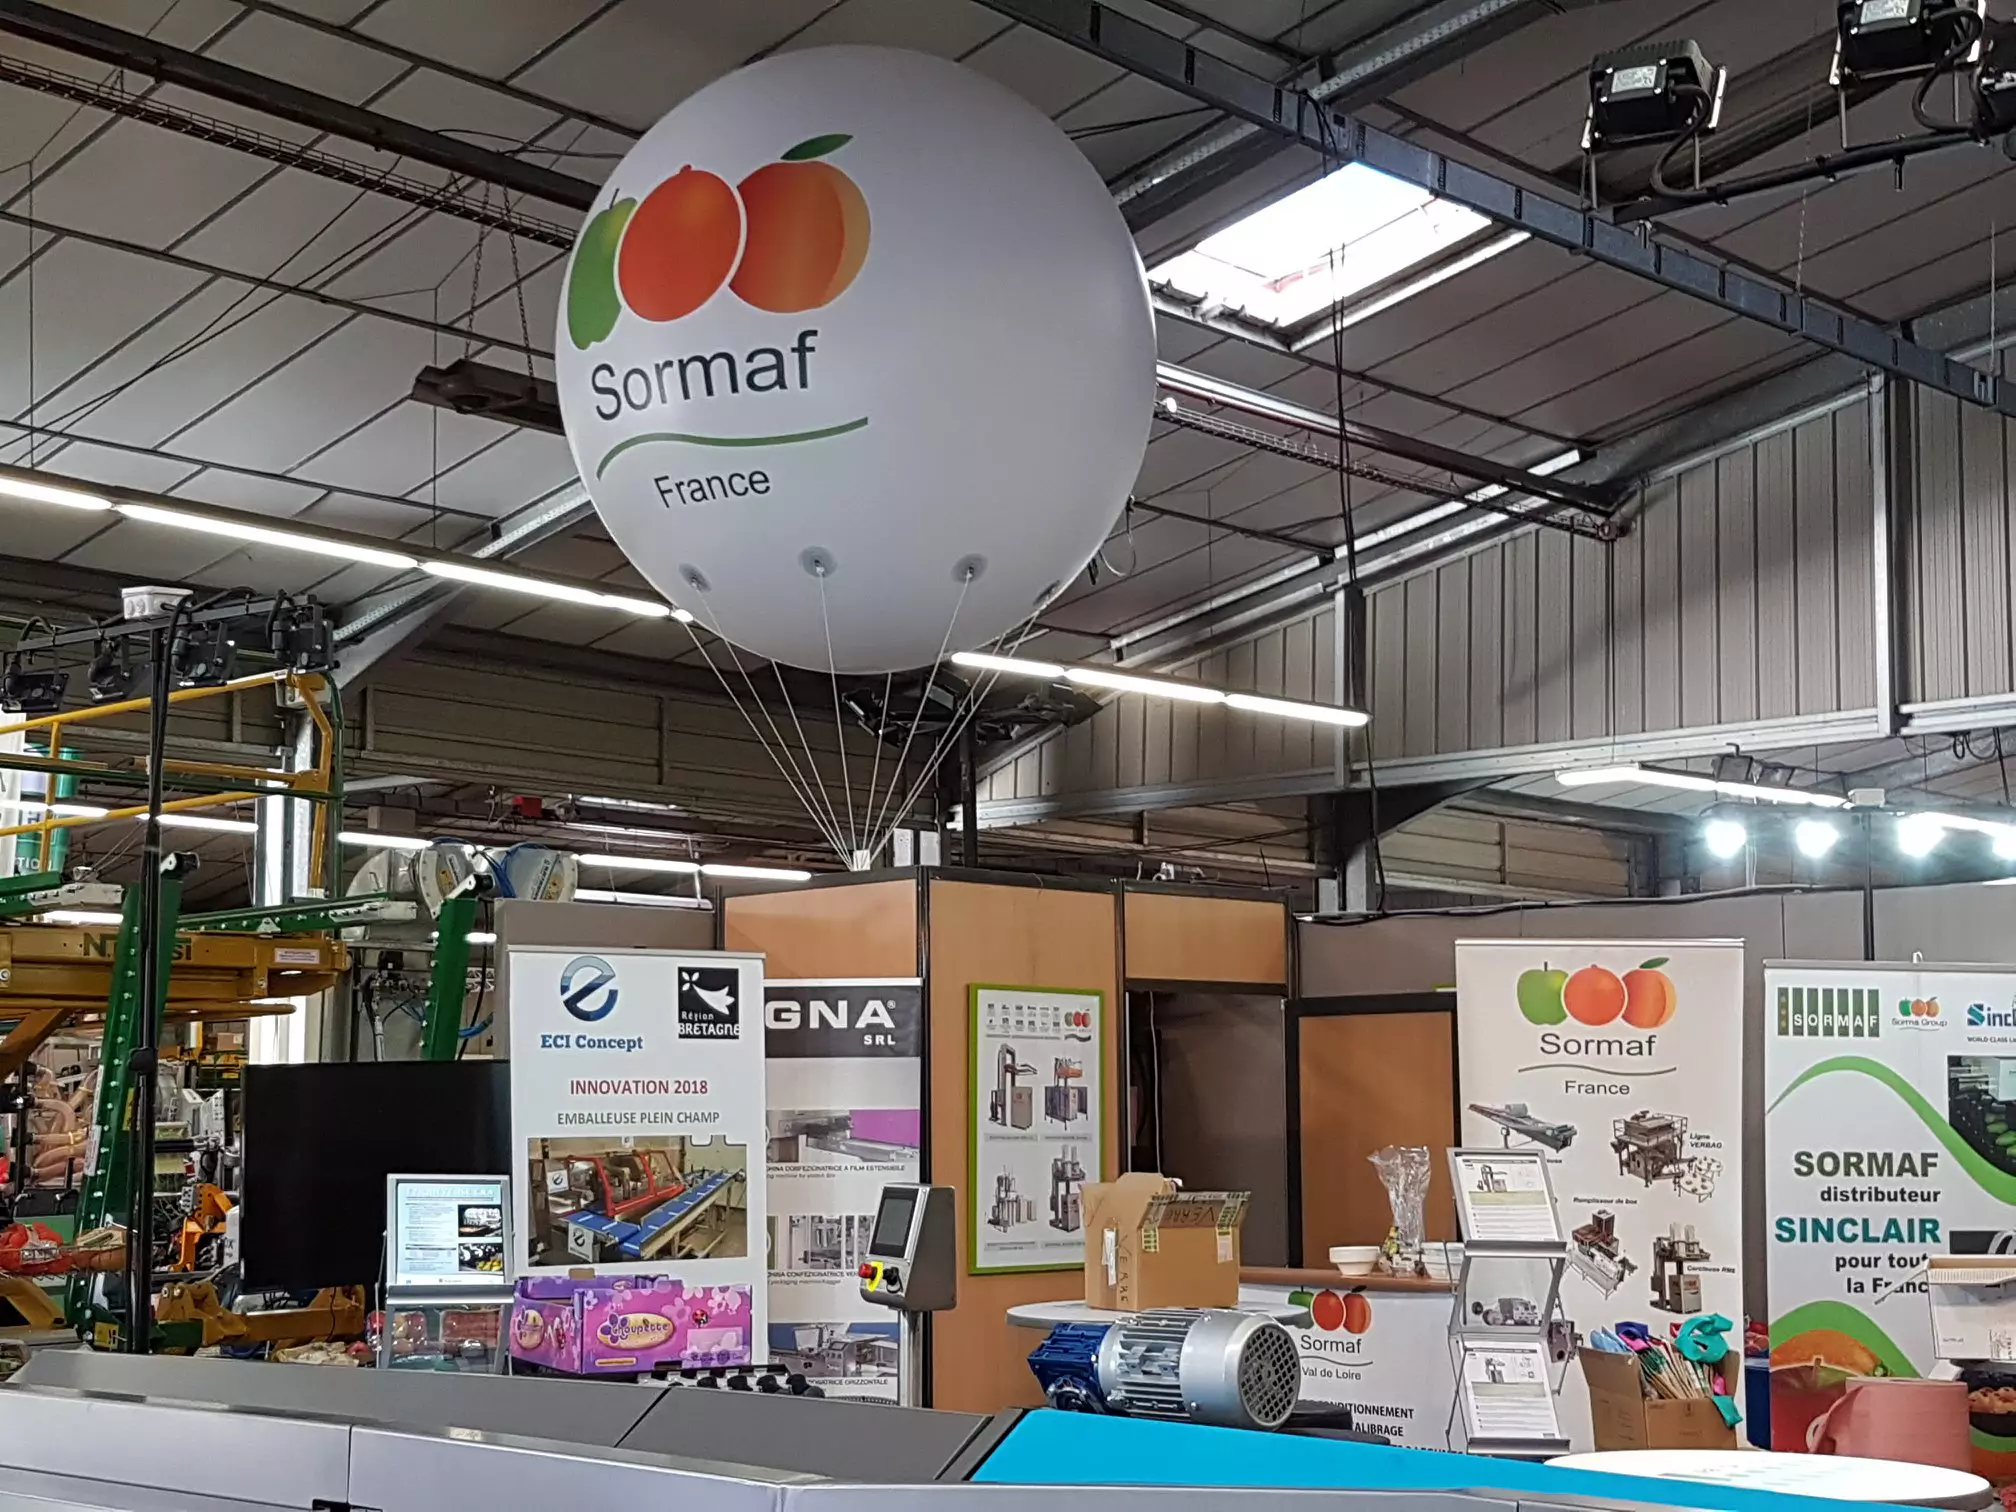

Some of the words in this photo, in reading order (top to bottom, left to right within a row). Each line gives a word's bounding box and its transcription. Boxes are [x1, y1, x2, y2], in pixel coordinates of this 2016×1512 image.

[591, 330, 818, 421] Sormaf
[654, 469, 771, 509] France
[1794, 1014, 1878, 1027] SORMAF
[678, 1022, 740, 1037] BRETAGNE
[540, 1034, 571, 1049] ECI
[575, 1035, 643, 1052] Concept
[864, 1034, 896, 1045] SRL
[1540, 1033, 1657, 1057] Sormaf
[570, 1080, 669, 1095] INNOVATION
[674, 1080, 708, 1094] 2018
[1564, 1080, 1631, 1096] France
[557, 1112, 637, 1125] EMBALLEUSE
[640, 1112, 673, 1124] PLEIN
[677, 1111, 720, 1124] CHAMP
[1794, 1151, 1939, 1178] SORMAF
[1820, 1186, 1941, 1203] distributeur
[1774, 1217, 1941, 1244] SINCLAIR
[1835, 1256, 1881, 1272] pour
[1846, 1277, 1865, 1293] la
[1300, 1334, 1362, 1354] Sormaf
[1302, 1366, 1318, 1377] Val
[1320, 1368, 1333, 1378] de
[1336, 1369, 1362, 1380] Loire
